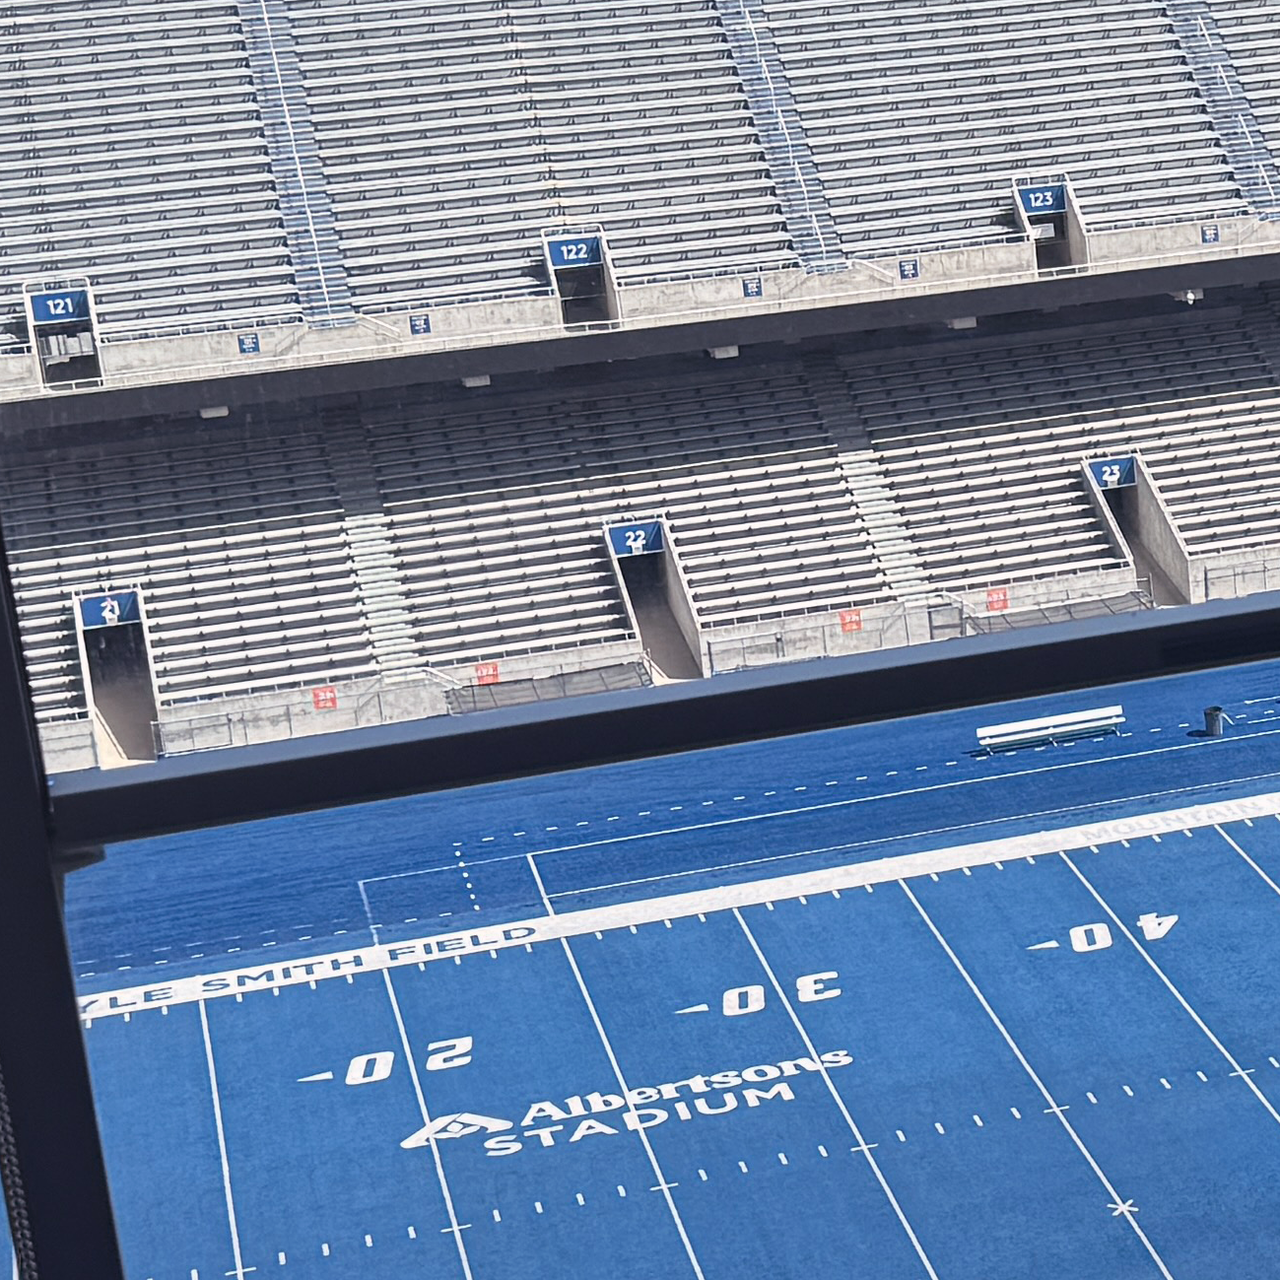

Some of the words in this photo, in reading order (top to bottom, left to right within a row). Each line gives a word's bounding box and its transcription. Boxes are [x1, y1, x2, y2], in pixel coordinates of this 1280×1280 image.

[1029, 191, 1053, 207] 123
[560, 243, 588, 260] 122
[46, 298, 74, 315] 121
[1101, 465, 1120, 481] 23
[625, 530, 646, 547] 22
[1080, 800, 1261, 841] MOUNTAIN
[1069, 912, 1179, 953] 40
[201, 955, 364, 993] SMITH
[388, 926, 537, 961] FIELD
[722, 971, 842, 1017] 30
[345, 1036, 474, 1086] 20
[520, 1049, 855, 1127] Albertsons
[486, 1082, 796, 1157] STADIUM
